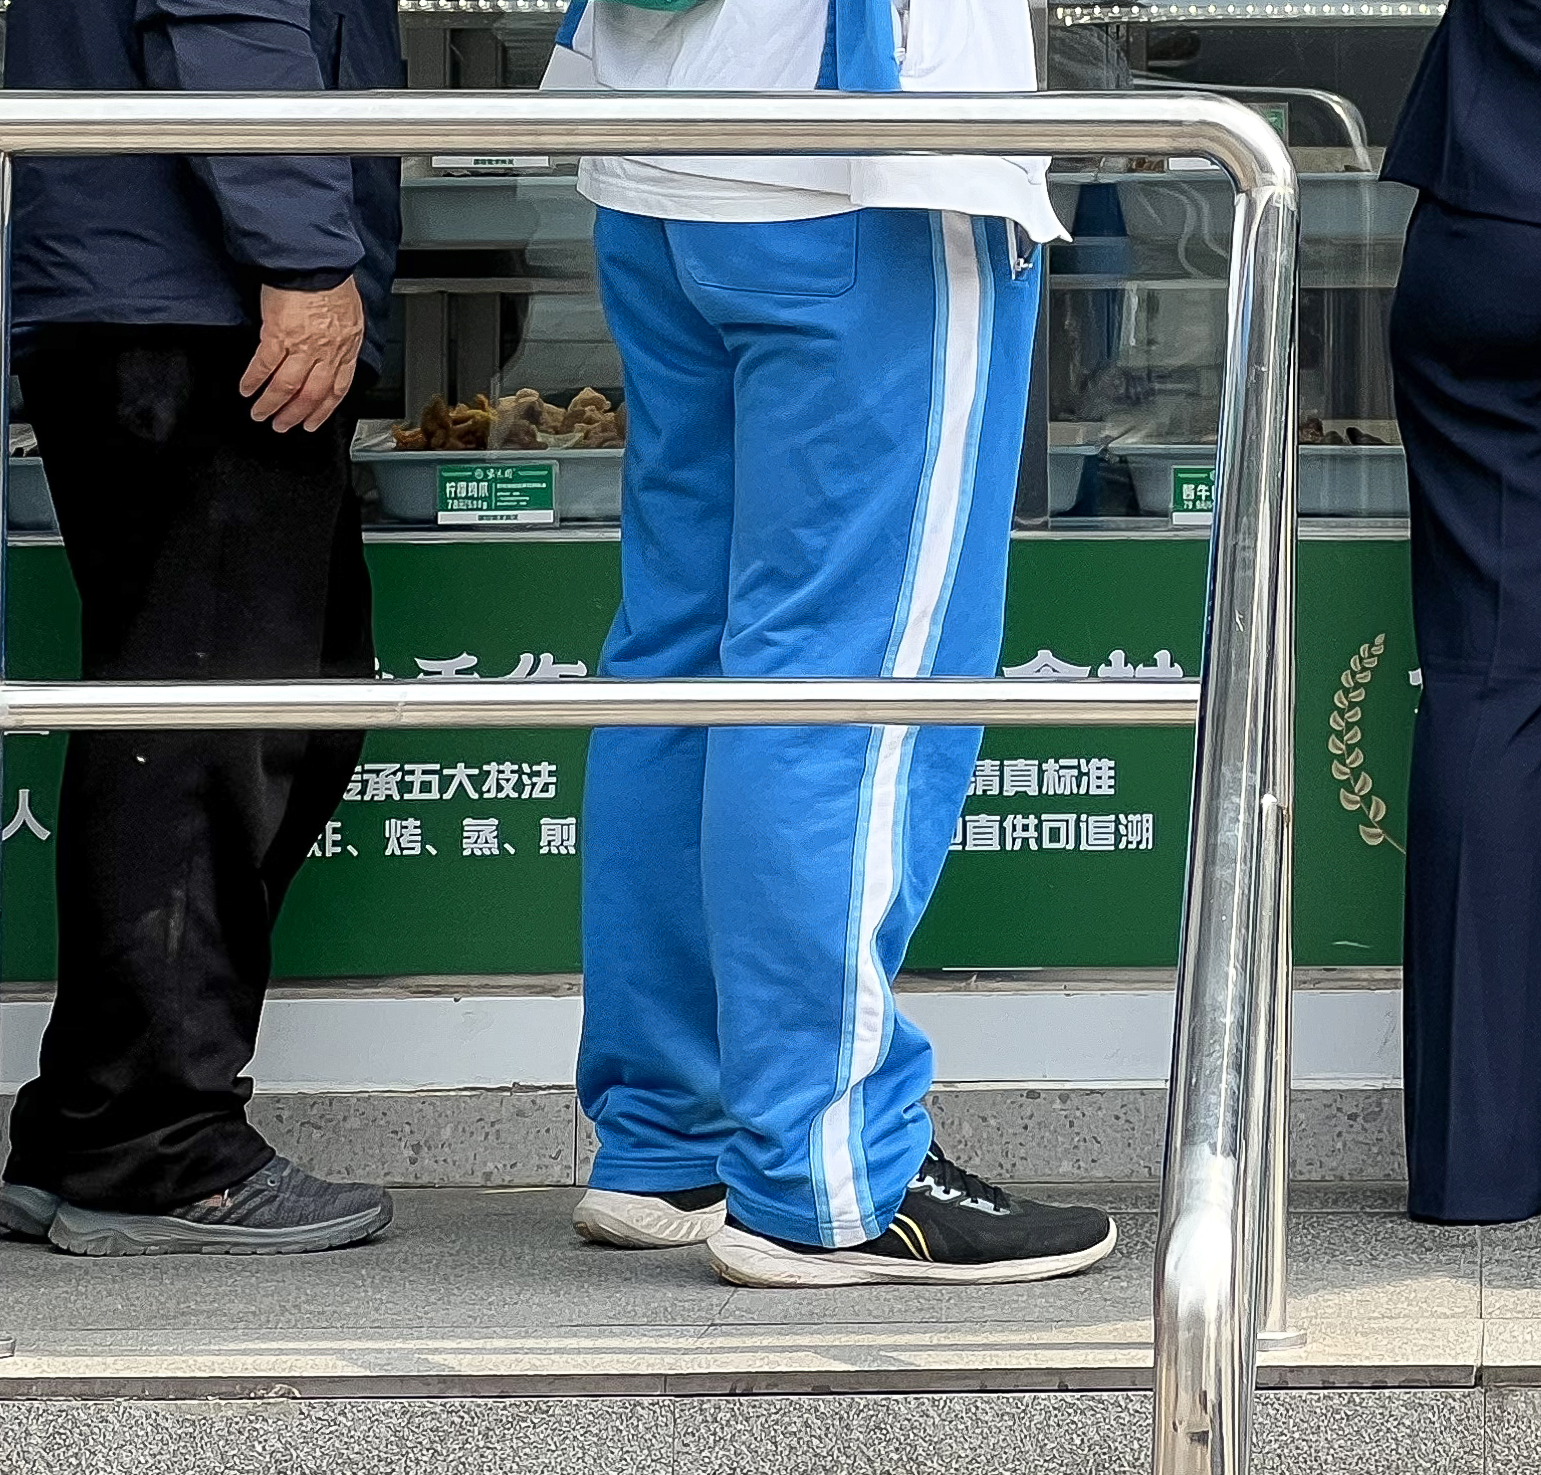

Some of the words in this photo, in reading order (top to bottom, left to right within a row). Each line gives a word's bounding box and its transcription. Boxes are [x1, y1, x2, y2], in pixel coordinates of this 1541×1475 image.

[1182, 483, 1214, 501] 酱牛
[966, 758, 1116, 796] 清真标准
